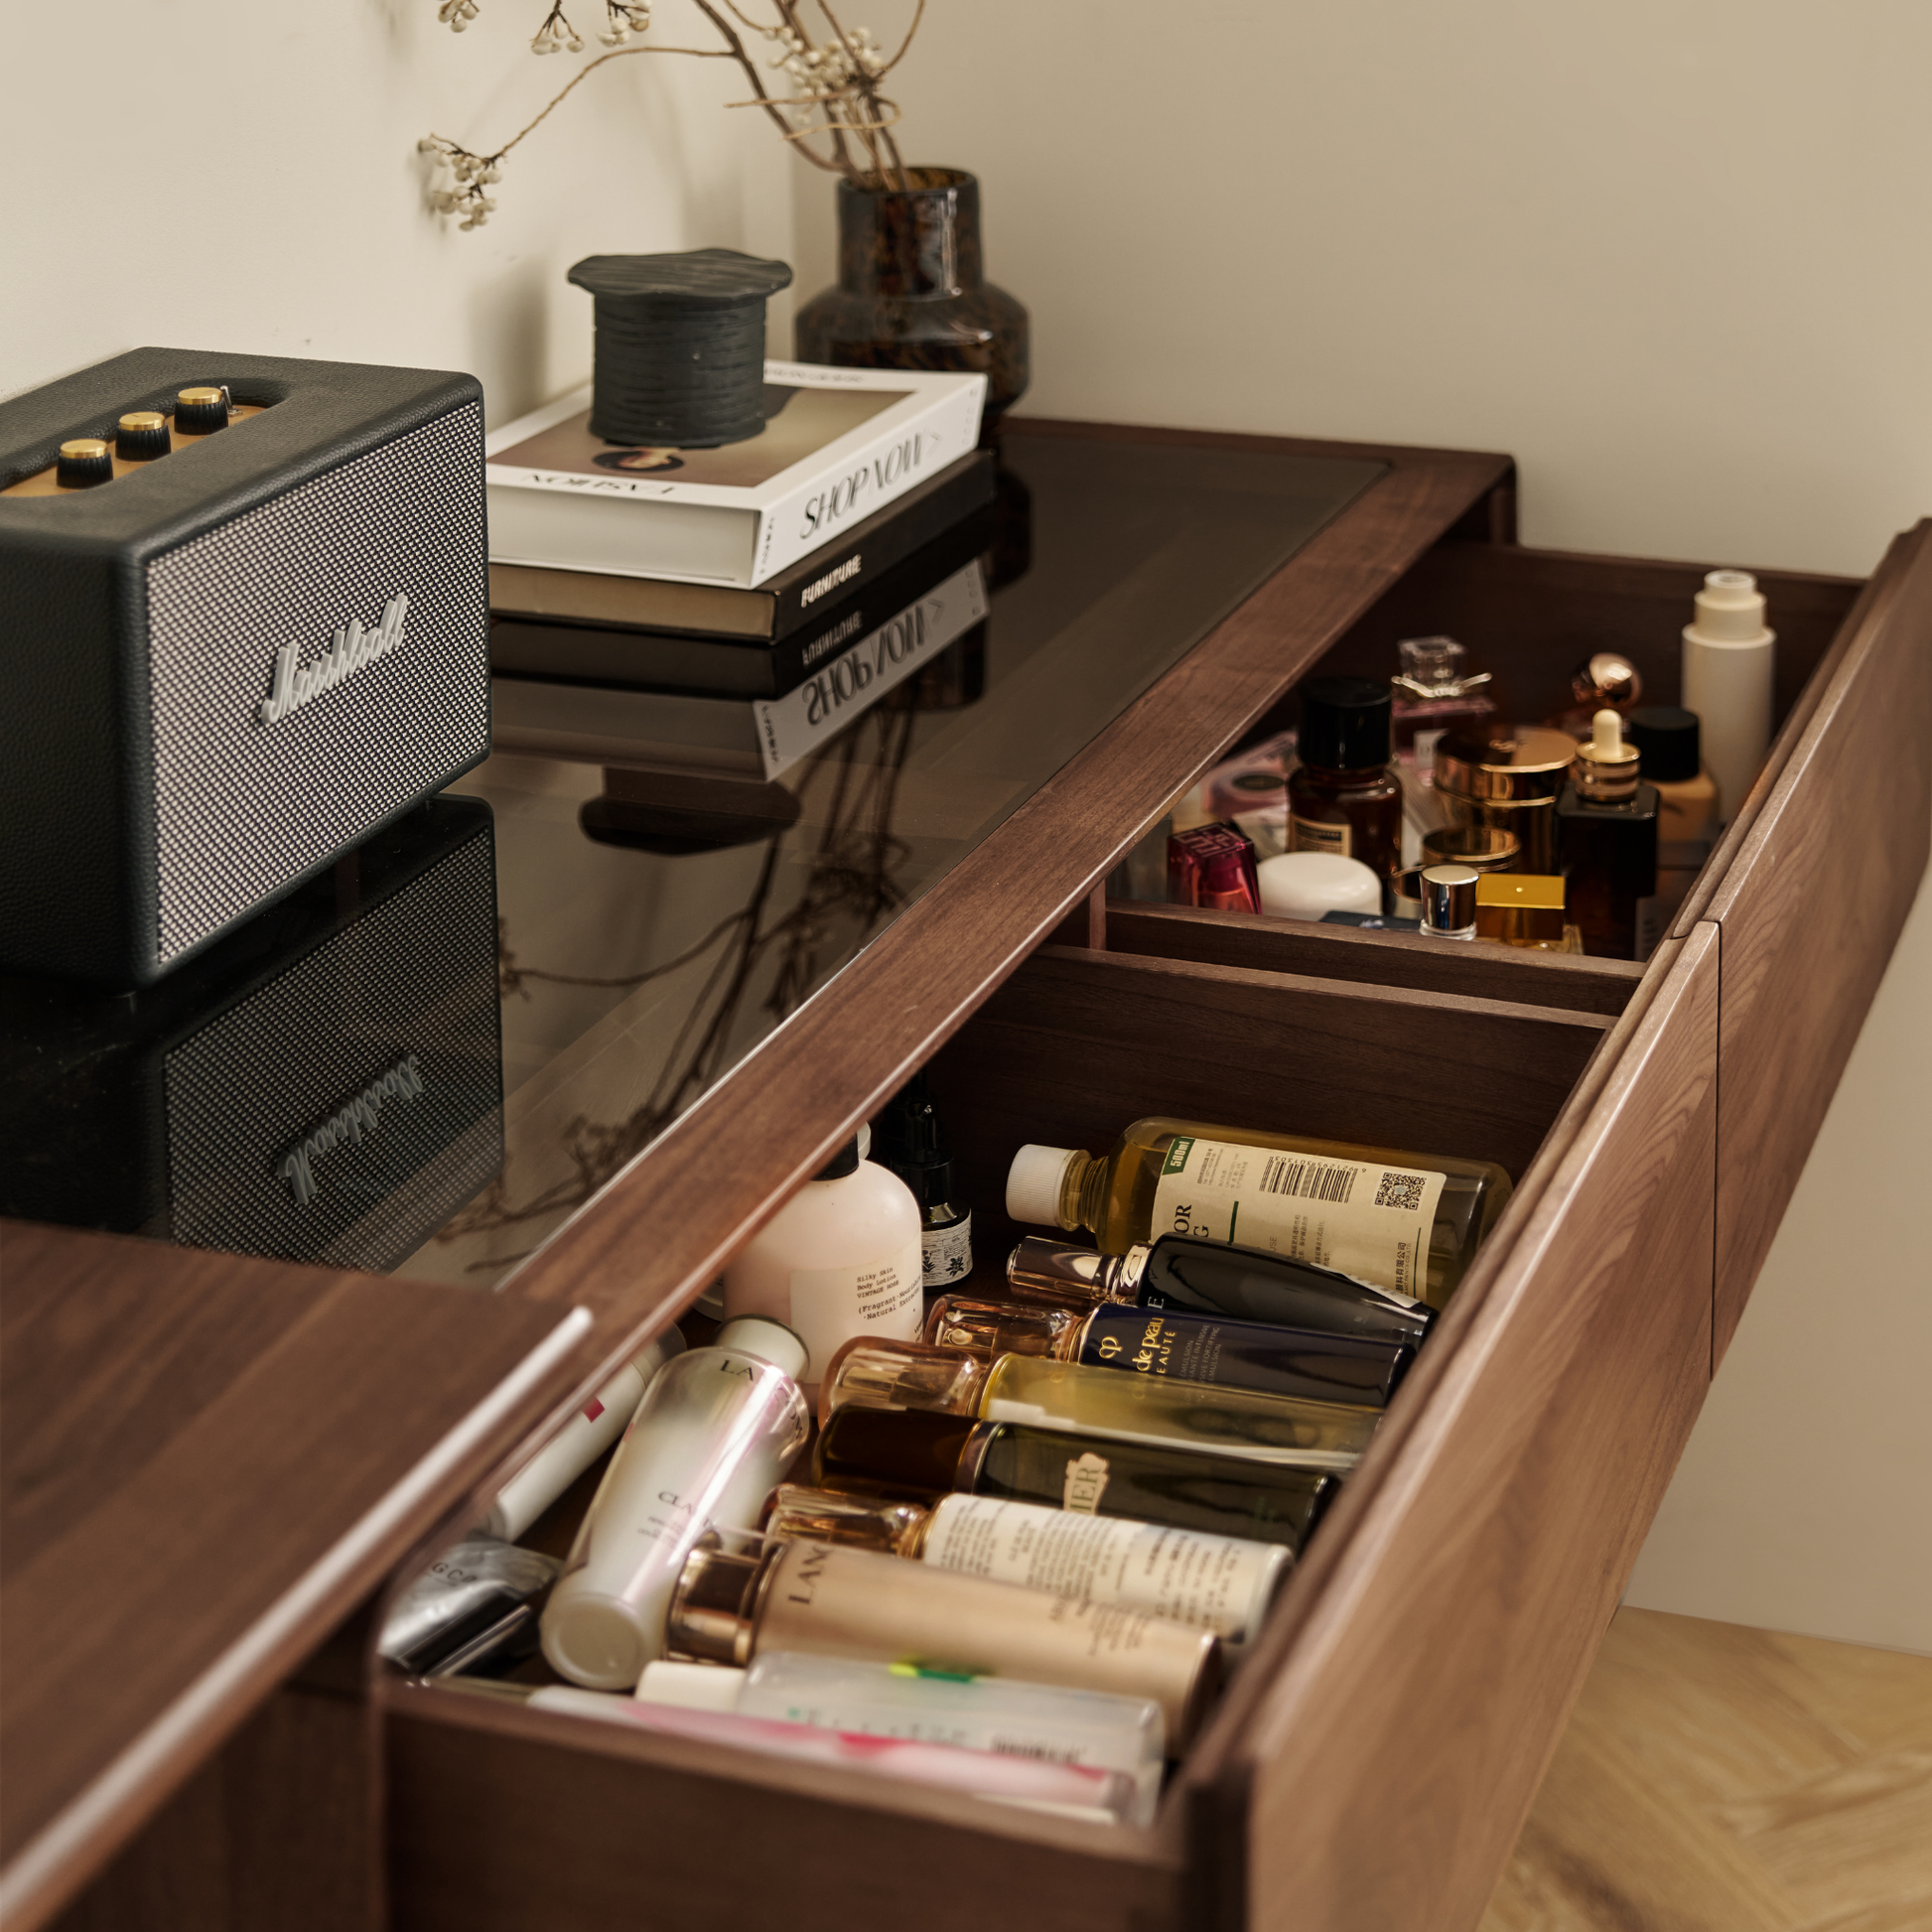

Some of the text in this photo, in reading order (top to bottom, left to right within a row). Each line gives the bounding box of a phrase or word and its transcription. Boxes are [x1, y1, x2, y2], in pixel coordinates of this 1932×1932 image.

[800, 430, 923, 539] SHOP NOW
[800, 553, 863, 608] FURNITURE
[260, 593, 408, 726] Marshall
[1170, 1141, 1190, 1168] 500ml
[1173, 1202, 1192, 1236] OR
[857, 1267, 894, 1283] Silky Skin
[857, 1280, 899, 1299] VINTAGE ROSE
[877, 1274, 897, 1286] Lotion
[1394, 1242, 1407, 1294] 颜料有限公司
[1132, 1317, 1165, 1372] de peau
[1156, 1330, 1175, 1374] EAUTÉ
